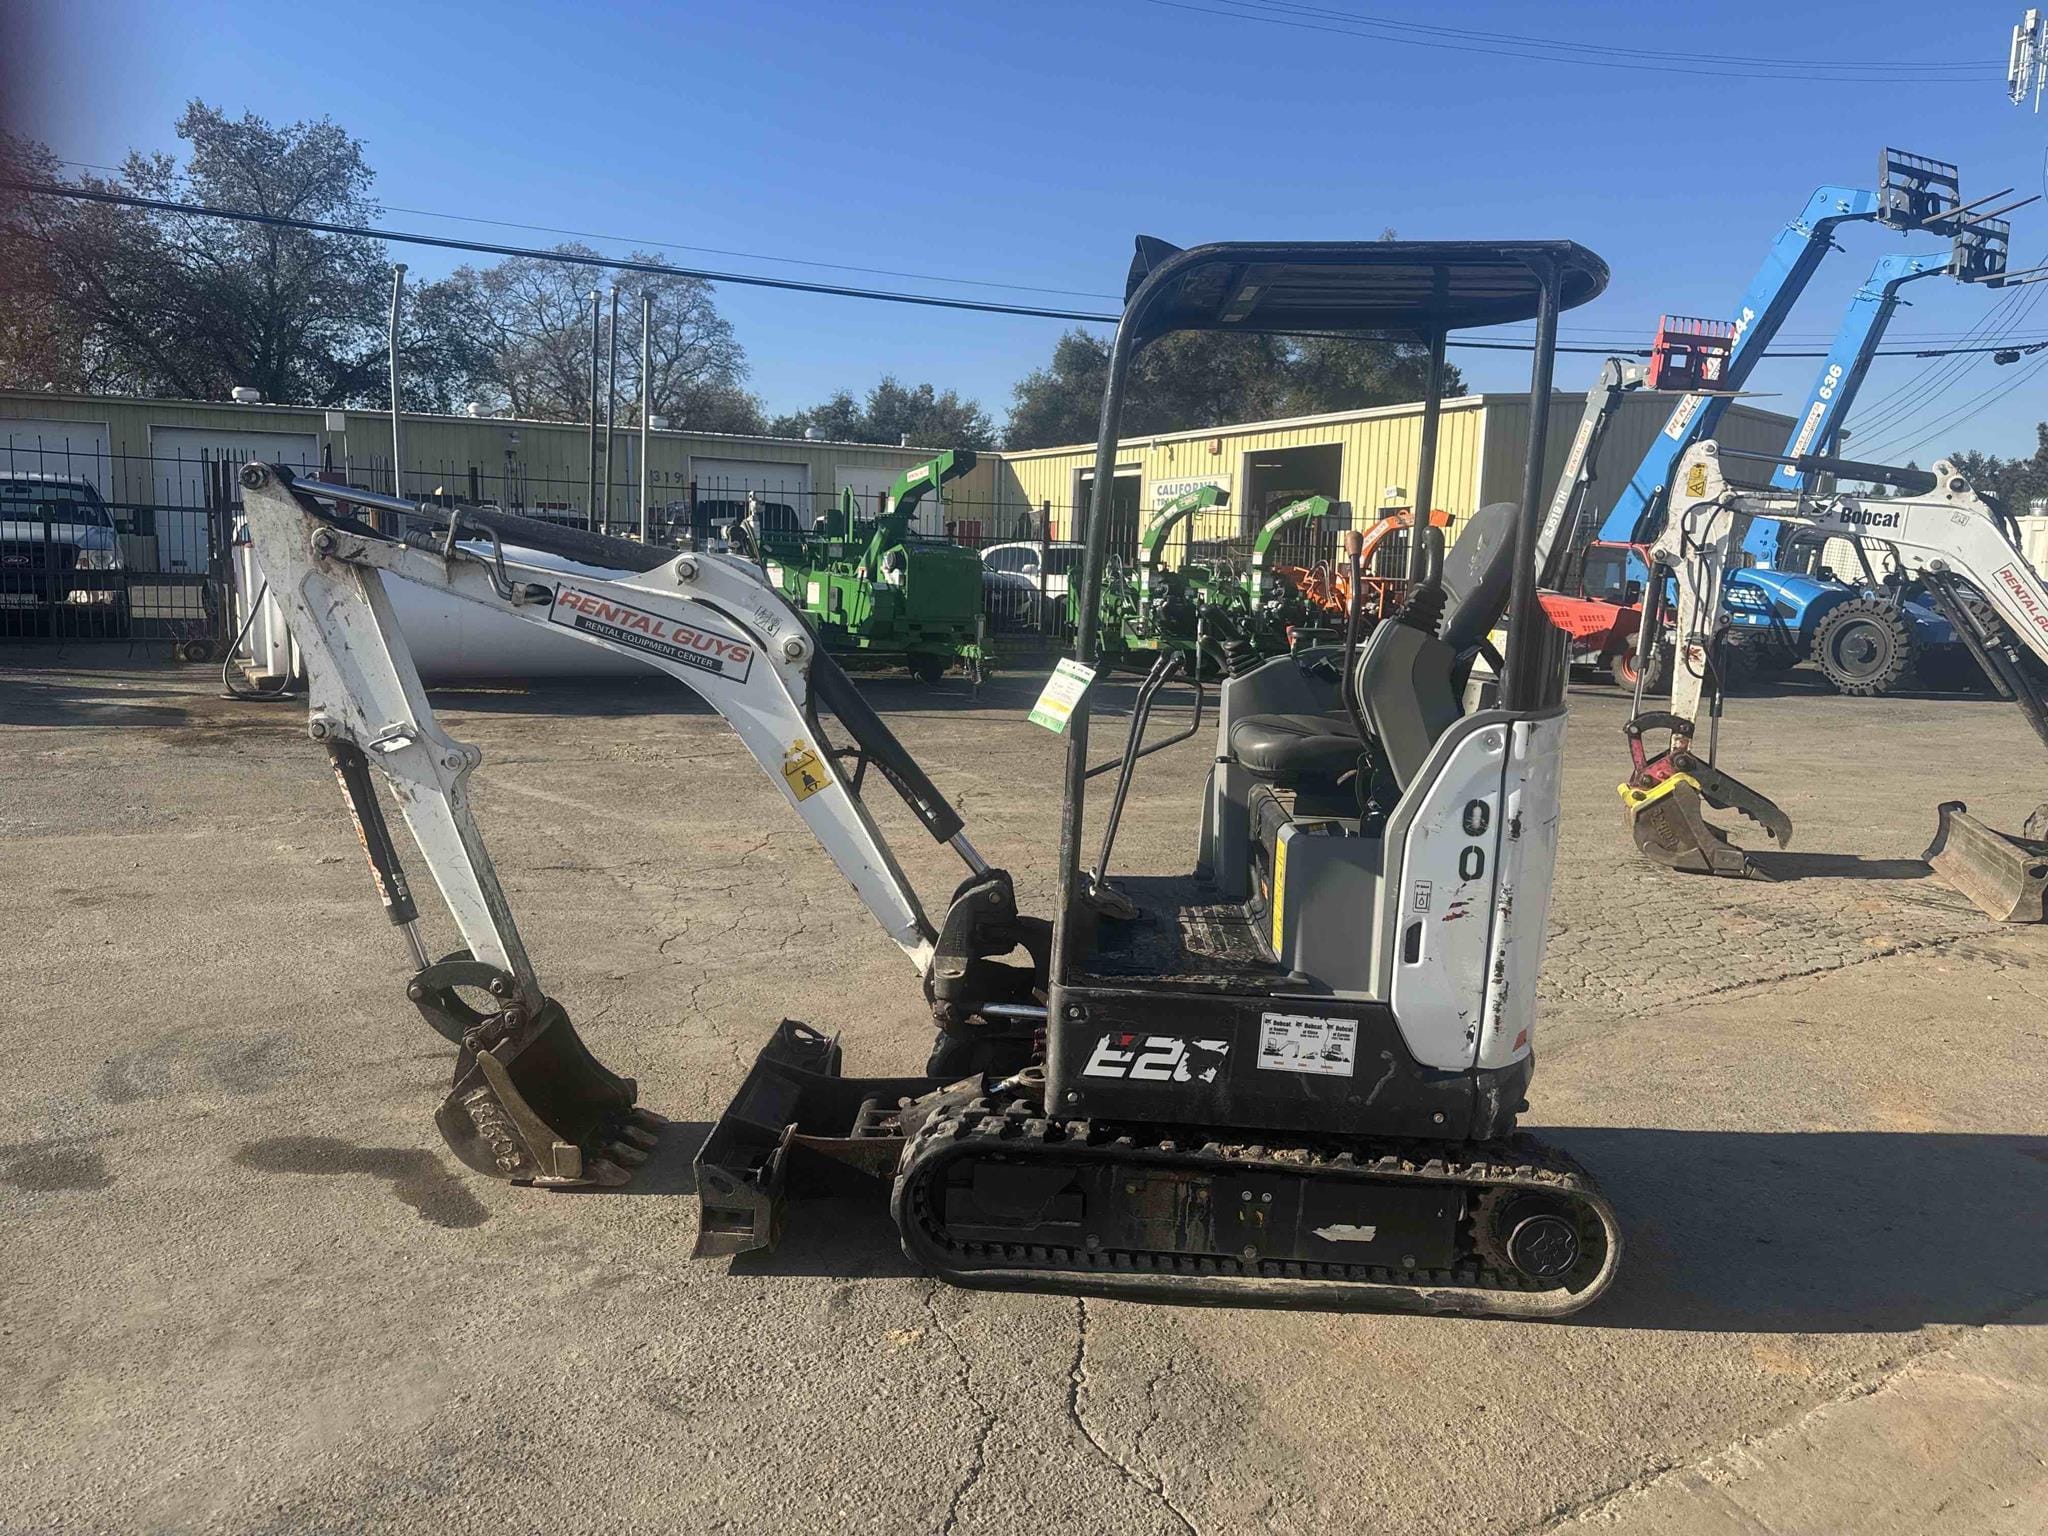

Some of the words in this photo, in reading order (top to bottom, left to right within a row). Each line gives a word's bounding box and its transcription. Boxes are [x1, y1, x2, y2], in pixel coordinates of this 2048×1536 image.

[1819, 363, 1842, 400] 636
[1568, 446, 1583, 474] RENTAL
[1840, 507, 1900, 528] Bobcat
[2000, 569, 2039, 616] RENTAL
[558, 591, 667, 638] RENTAL
[672, 628, 750, 663] GUYS
[585, 620, 620, 638] RENTAL
[622, 632, 676, 655] EQUIPMENT
[677, 650, 713, 667] CENTER
